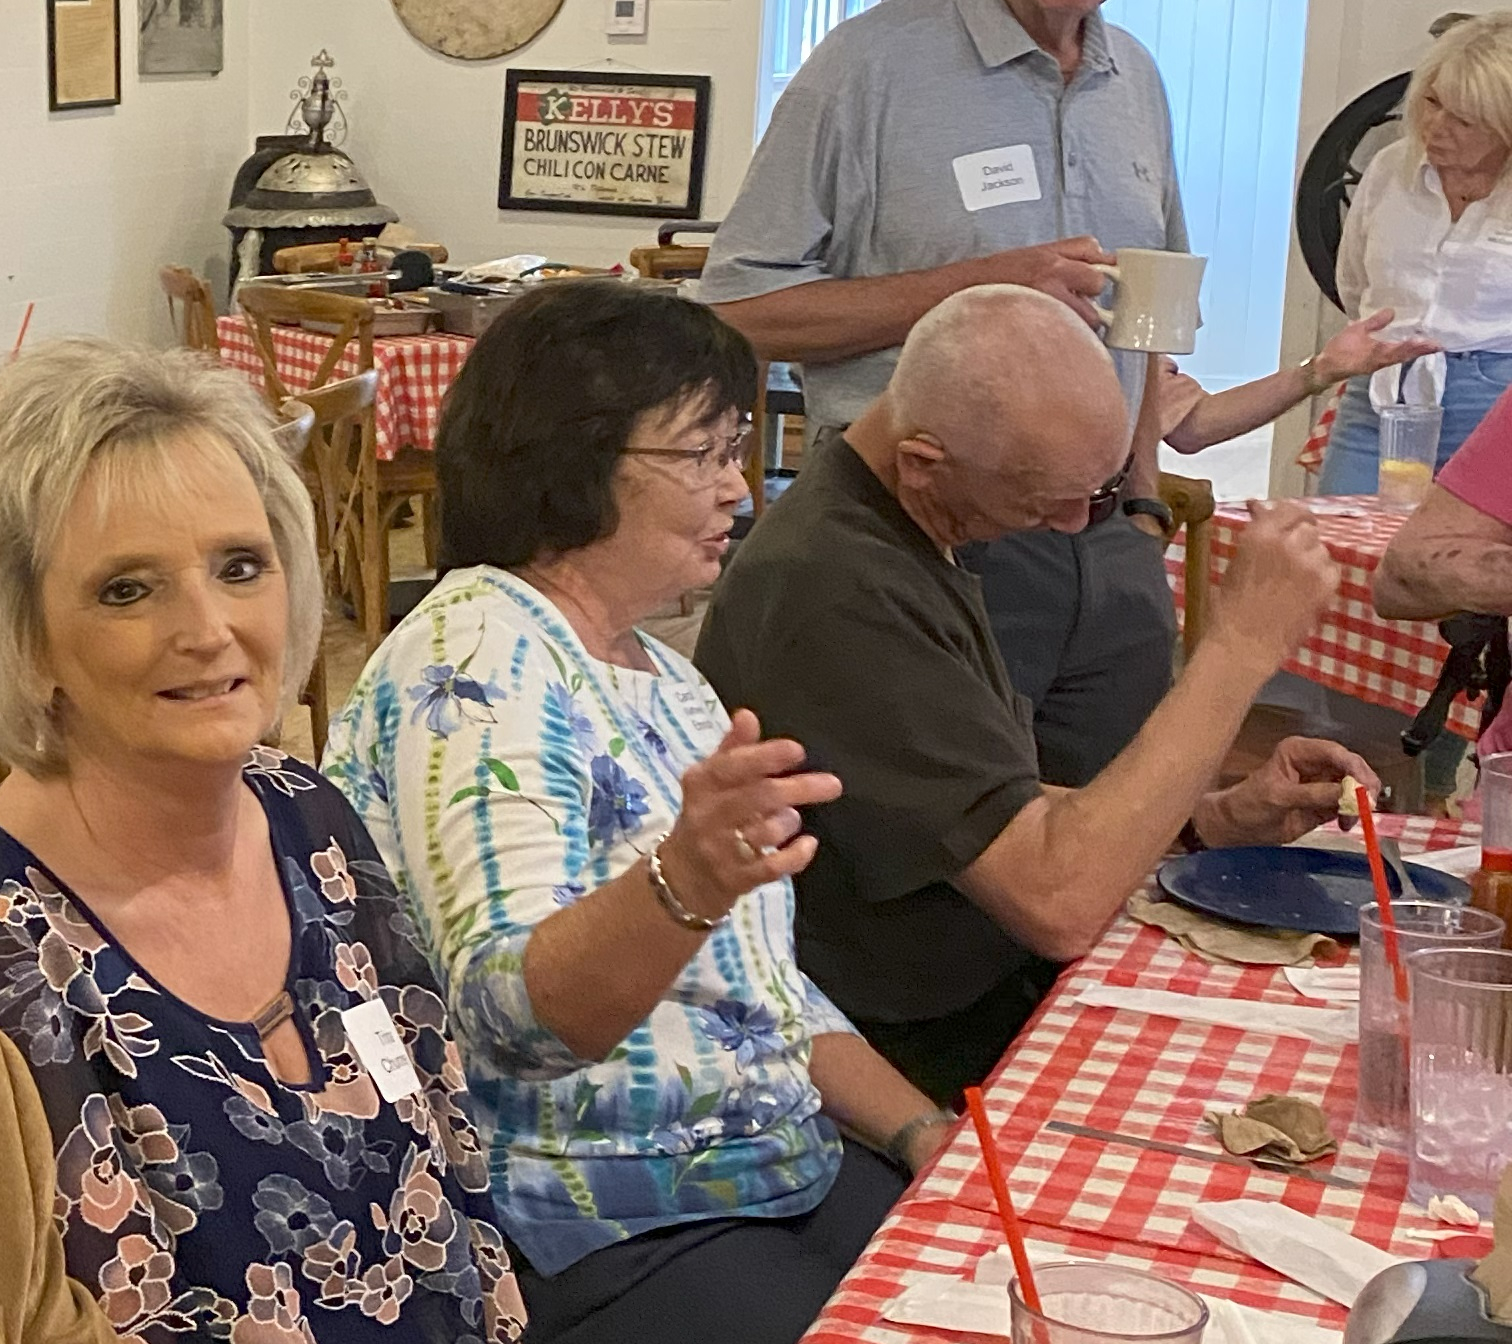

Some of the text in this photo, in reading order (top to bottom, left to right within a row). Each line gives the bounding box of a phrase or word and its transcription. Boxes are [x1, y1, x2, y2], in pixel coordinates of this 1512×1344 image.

[544, 96, 675, 127] KELLY'S
[524, 128, 686, 159] BRUNSWICK STEW
[523, 158, 670, 184] CHILI CON CARNE
[982, 162, 1013, 176] David
[981, 177, 1024, 192] Jackson
